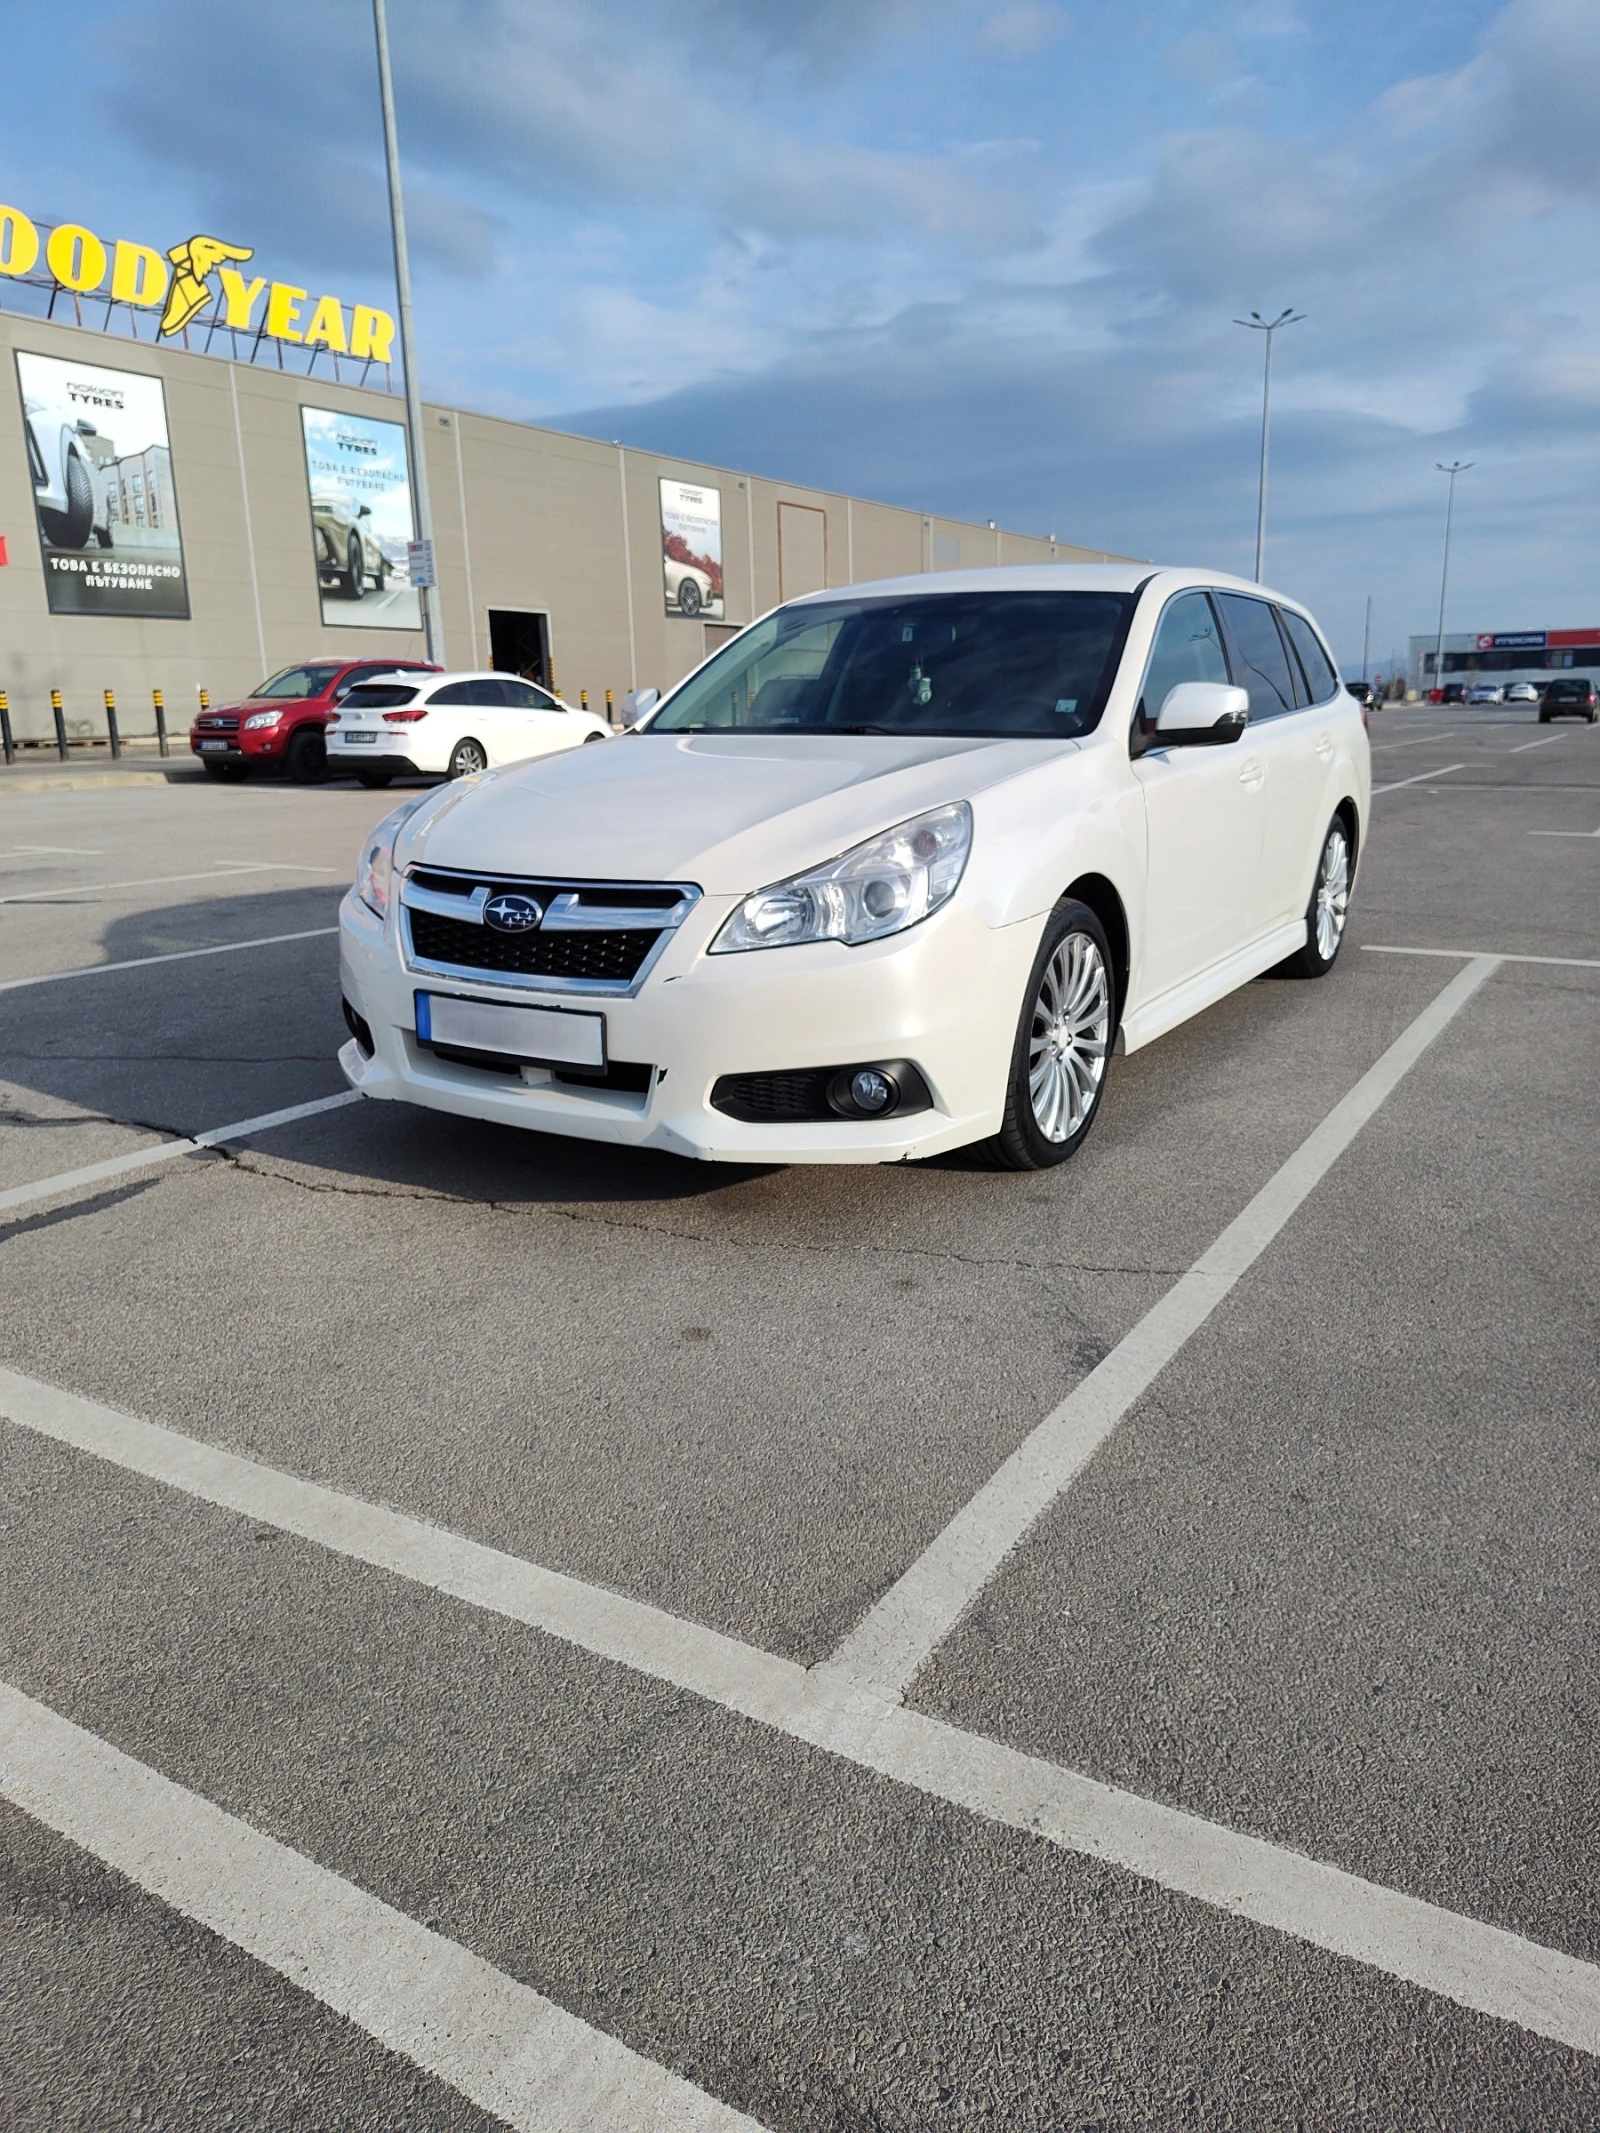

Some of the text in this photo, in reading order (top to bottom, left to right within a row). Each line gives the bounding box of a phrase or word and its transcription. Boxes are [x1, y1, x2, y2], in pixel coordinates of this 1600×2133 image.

[218, 267, 395, 364] YEAR
[68, 391, 124, 409] TYRES
[337, 442, 378, 455] TYRES
[50, 558, 180, 578] ТОВА Е БЕЗОПАСНО
[85, 575, 153, 589] ПЪТУВАНЕ
